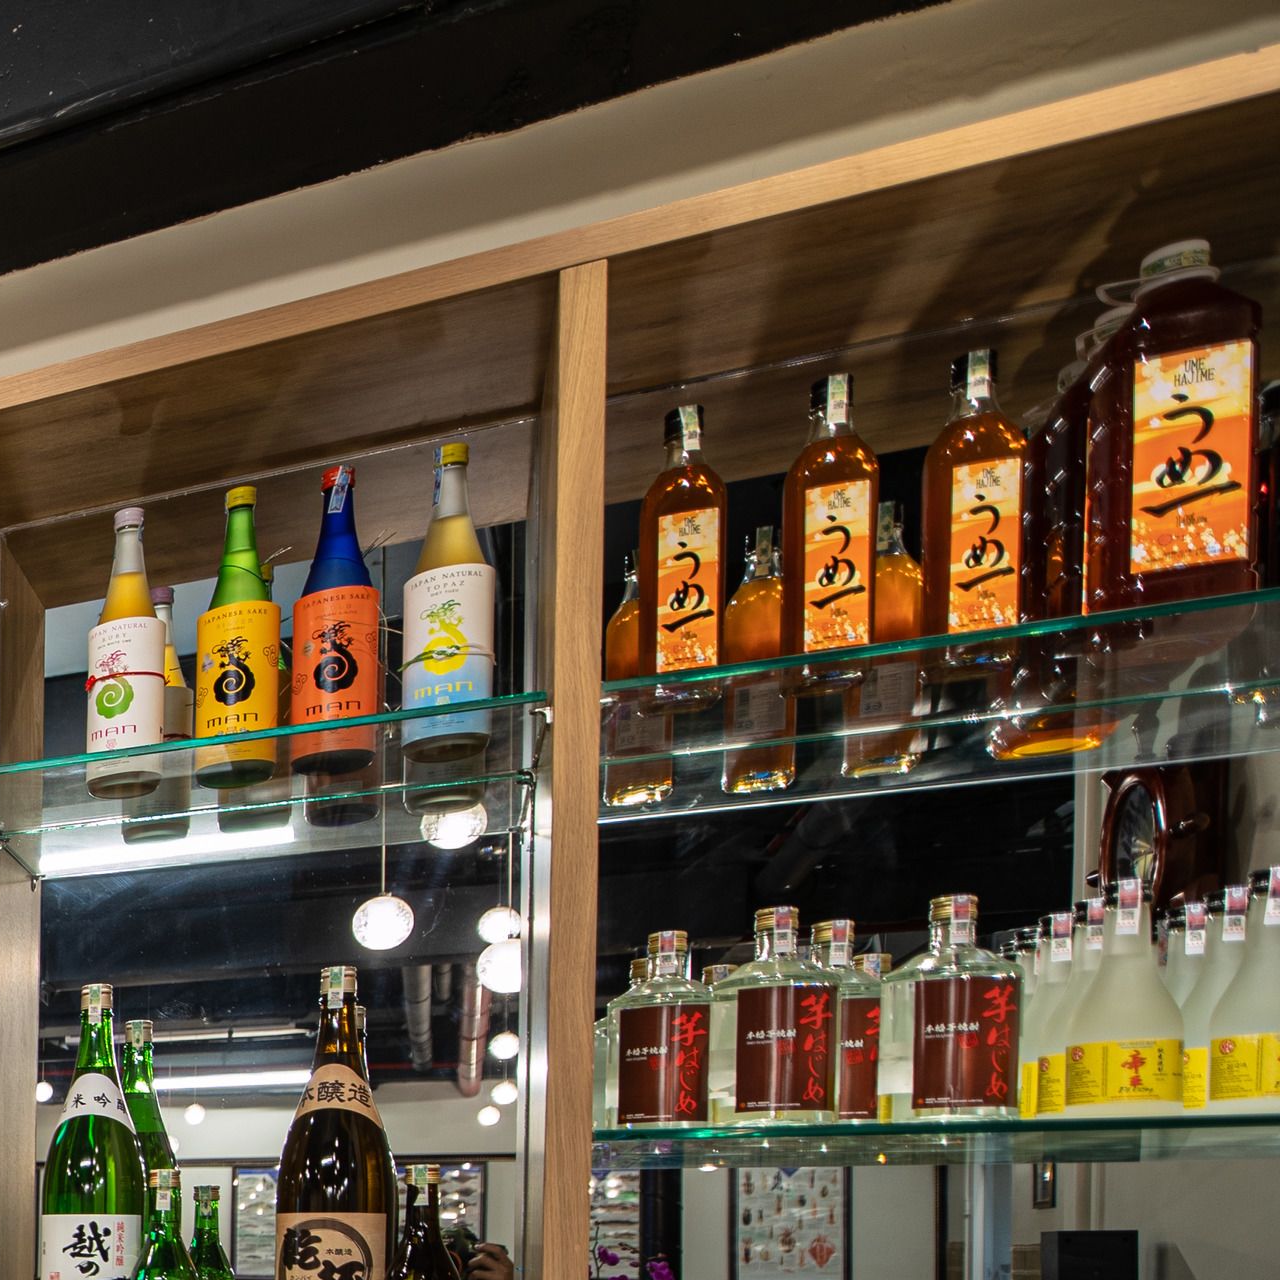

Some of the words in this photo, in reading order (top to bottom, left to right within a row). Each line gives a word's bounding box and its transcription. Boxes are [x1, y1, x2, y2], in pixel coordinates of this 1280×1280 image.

[1184, 357, 1206, 372] UME
[1174, 367, 1216, 388] HAJIME
[442, 569, 483, 580] NATURAL
[426, 580, 465, 593] TOPAZ
[303, 594, 346, 609] JAPANESE
[349, 592, 370, 600] SAKE
[202, 610, 243, 626] JAPANESE
[111, 622, 148, 632] NATURAL
[800, 991, 832, 1103] 芋はじめ
[981, 984, 1018, 1100] 芋はじめ
[671, 1011, 708, 1115] 芋はじめ
[301, 1080, 372, 1109] 本醸造
[115, 1221, 125, 1267] 純米吟醸
[325, 1247, 354, 1257] 本醸造
